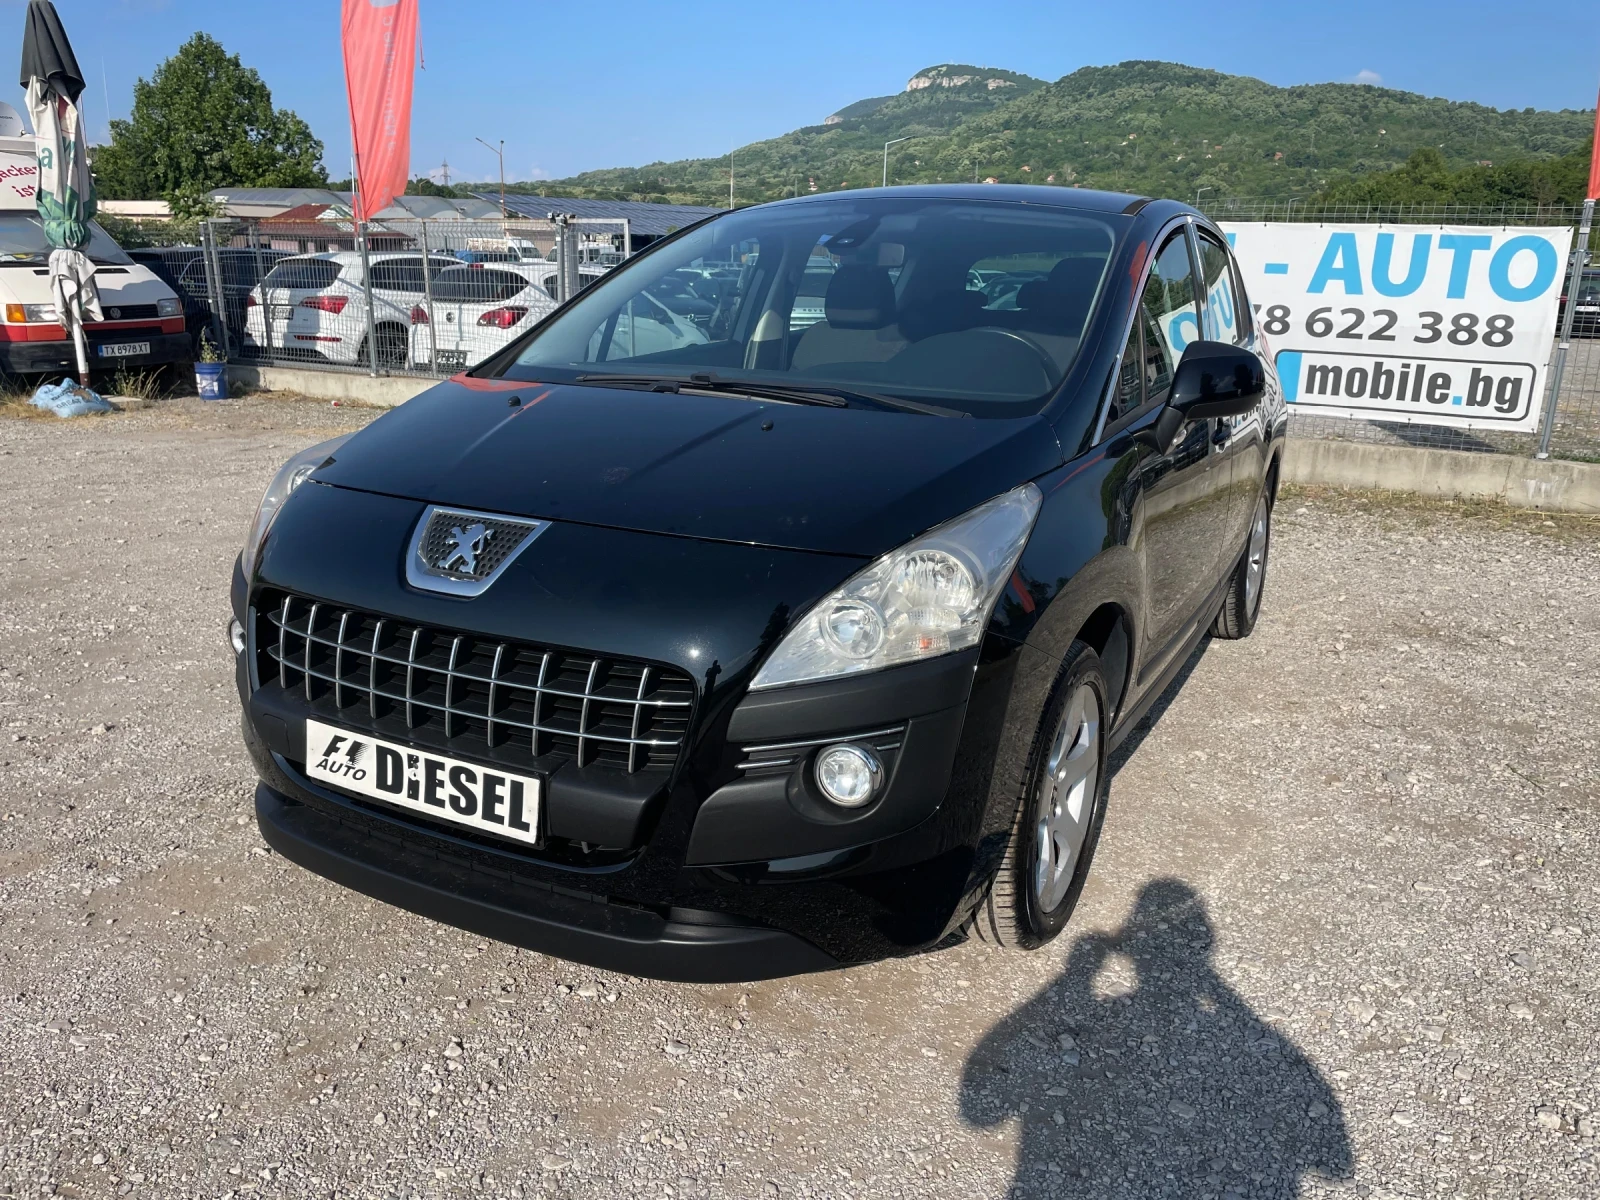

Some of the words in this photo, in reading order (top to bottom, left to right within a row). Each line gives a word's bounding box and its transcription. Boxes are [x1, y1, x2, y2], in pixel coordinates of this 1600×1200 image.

[1306, 231, 1558, 302] AUTO
[1305, 307, 1398, 341] 622
[1413, 311, 1515, 347] 388
[1305, 361, 1523, 414] mobile.bg
[315, 758, 367, 781] AUTO
